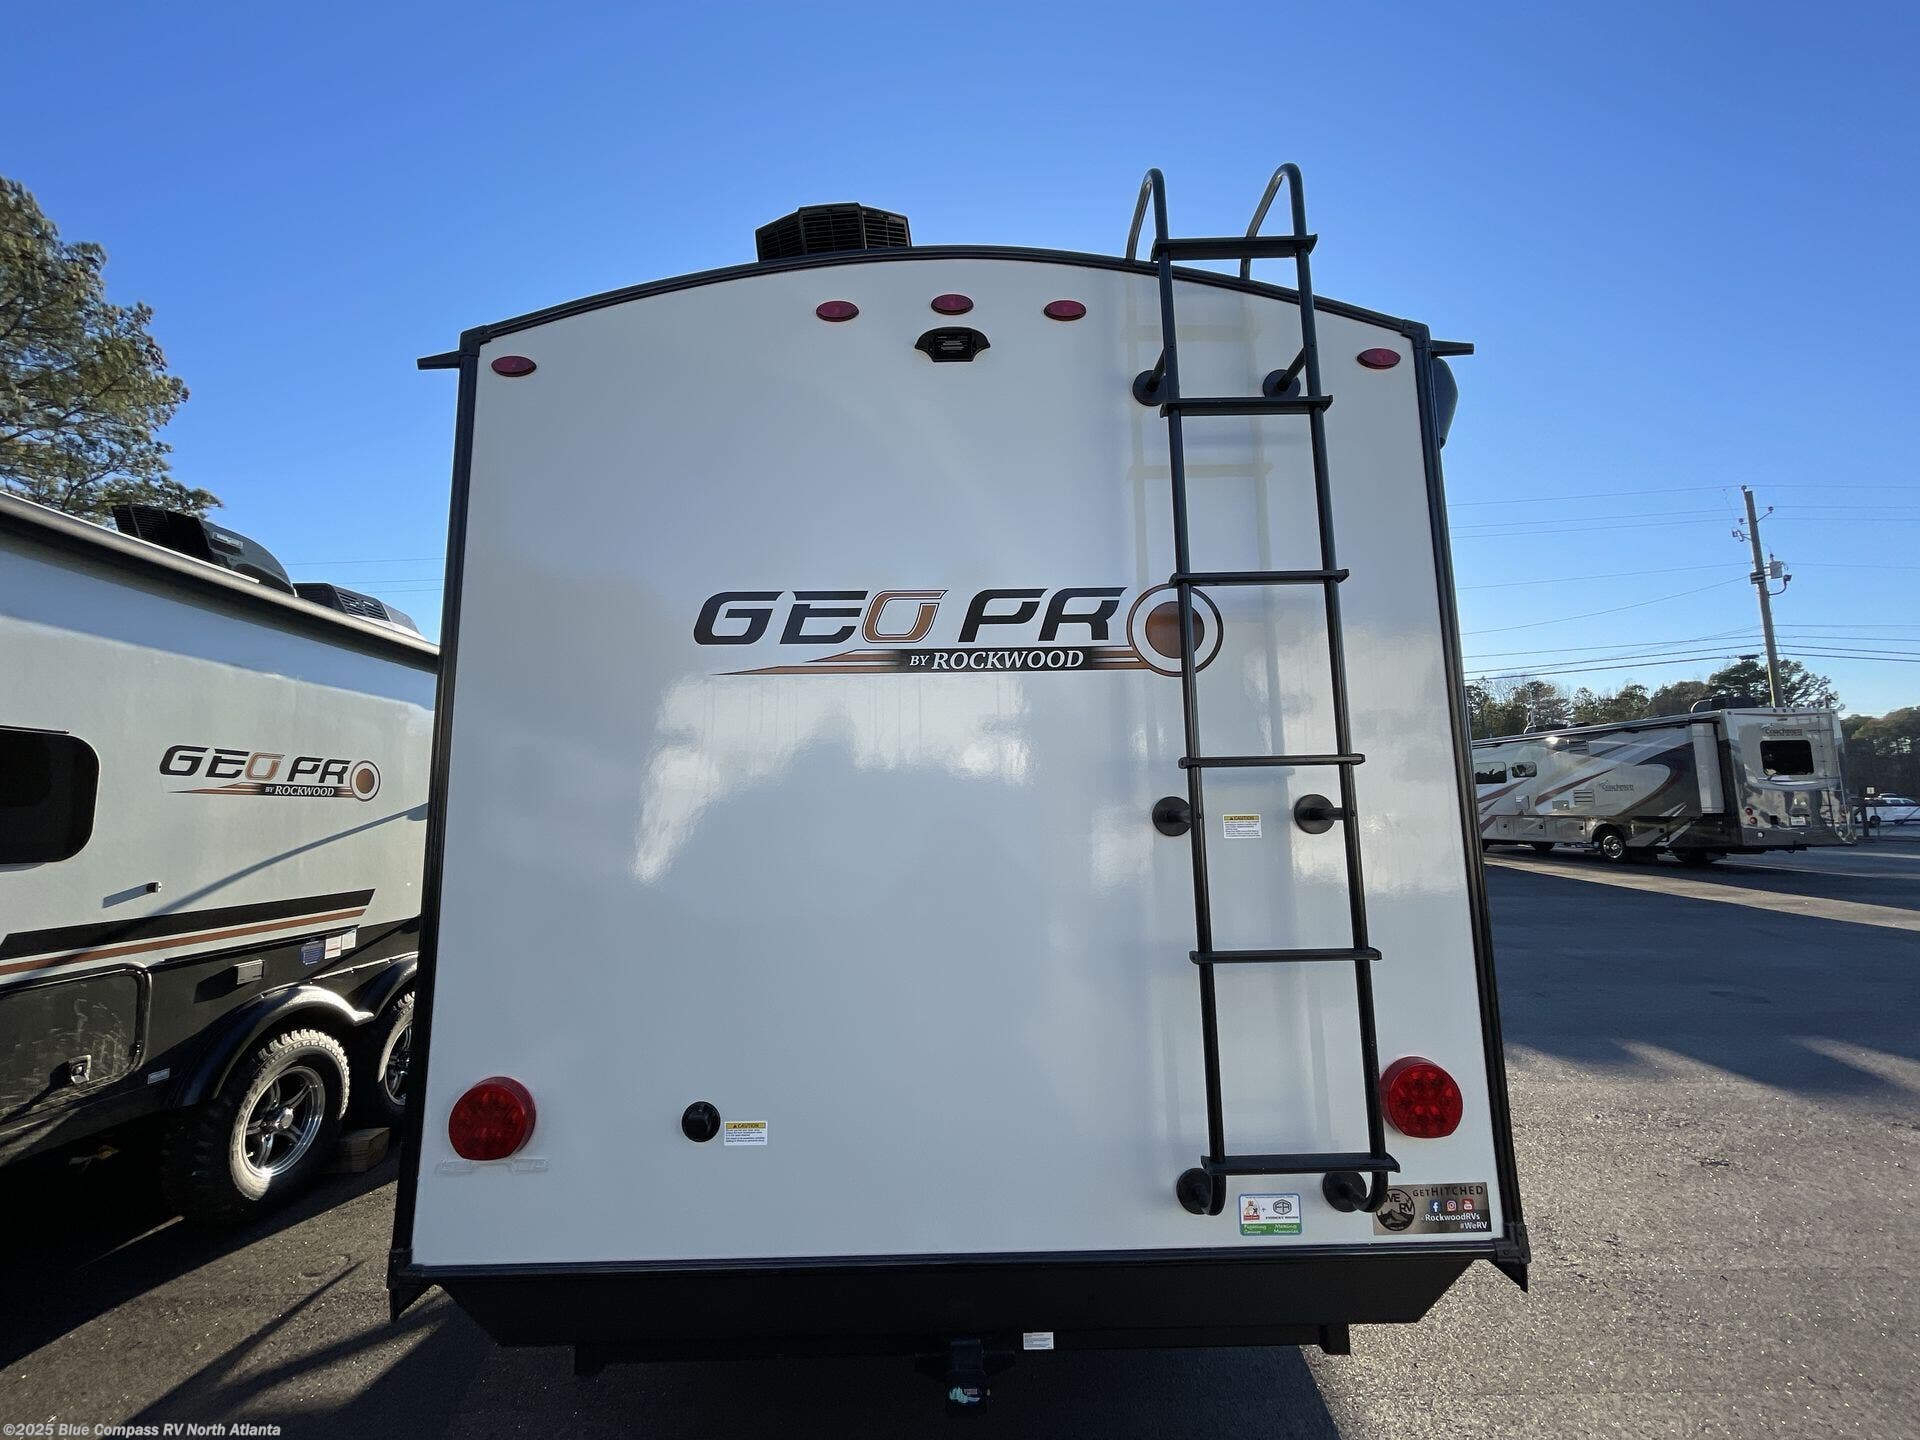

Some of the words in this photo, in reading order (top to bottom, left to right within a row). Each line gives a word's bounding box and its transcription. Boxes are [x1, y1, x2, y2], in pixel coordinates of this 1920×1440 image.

[693, 589, 948, 645] GEO
[909, 655, 929, 668] BY
[931, 650, 1085, 671] ROCKWOOD
[159, 745, 285, 782] GEO
[274, 785, 335, 797] ROCKWOOD
[1400, 1202, 1413, 1213] RV
[1425, 1213, 1480, 1222] RockwoodRVs
[1460, 1221, 1487, 1230] #WeRV
